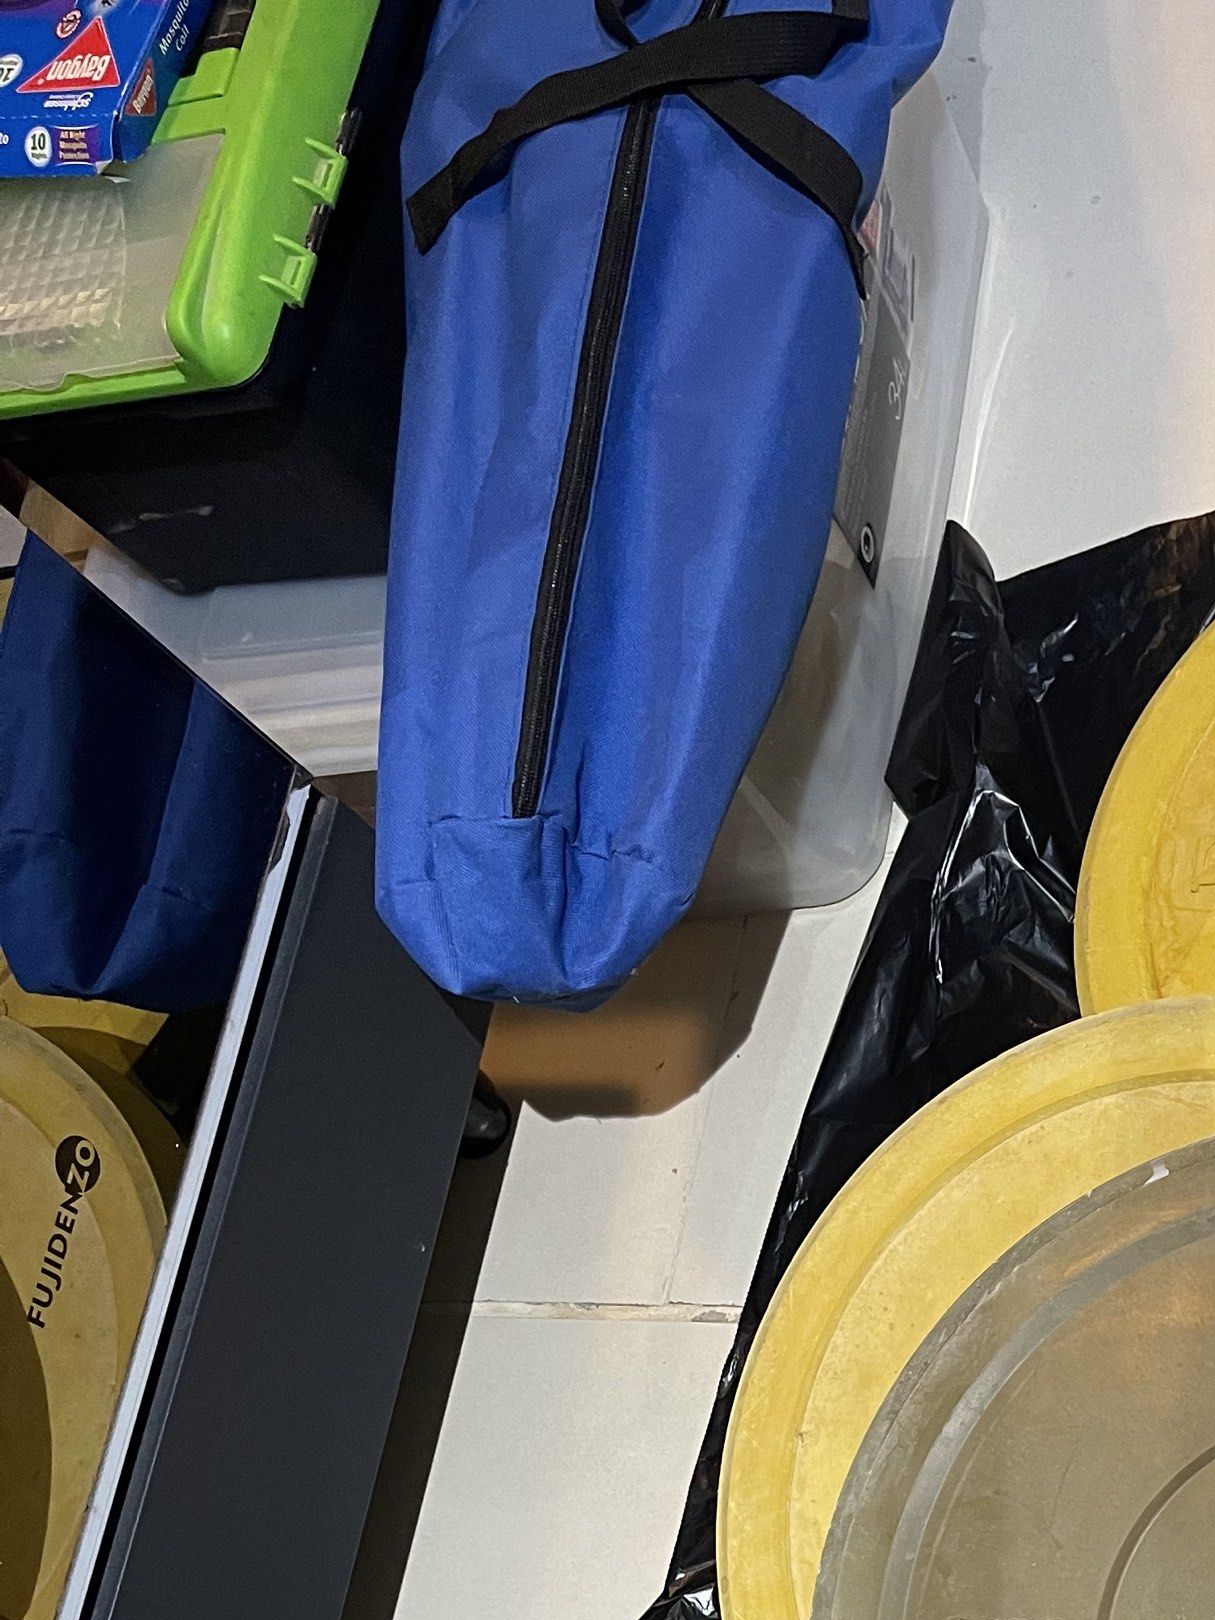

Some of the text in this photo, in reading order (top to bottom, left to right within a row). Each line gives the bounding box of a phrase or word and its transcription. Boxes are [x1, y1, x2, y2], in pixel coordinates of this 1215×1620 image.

[46, 54, 111, 81] Baygon
[30, 133, 46, 150] 10
[27, 1137, 98, 1328] FUJIDENZO
